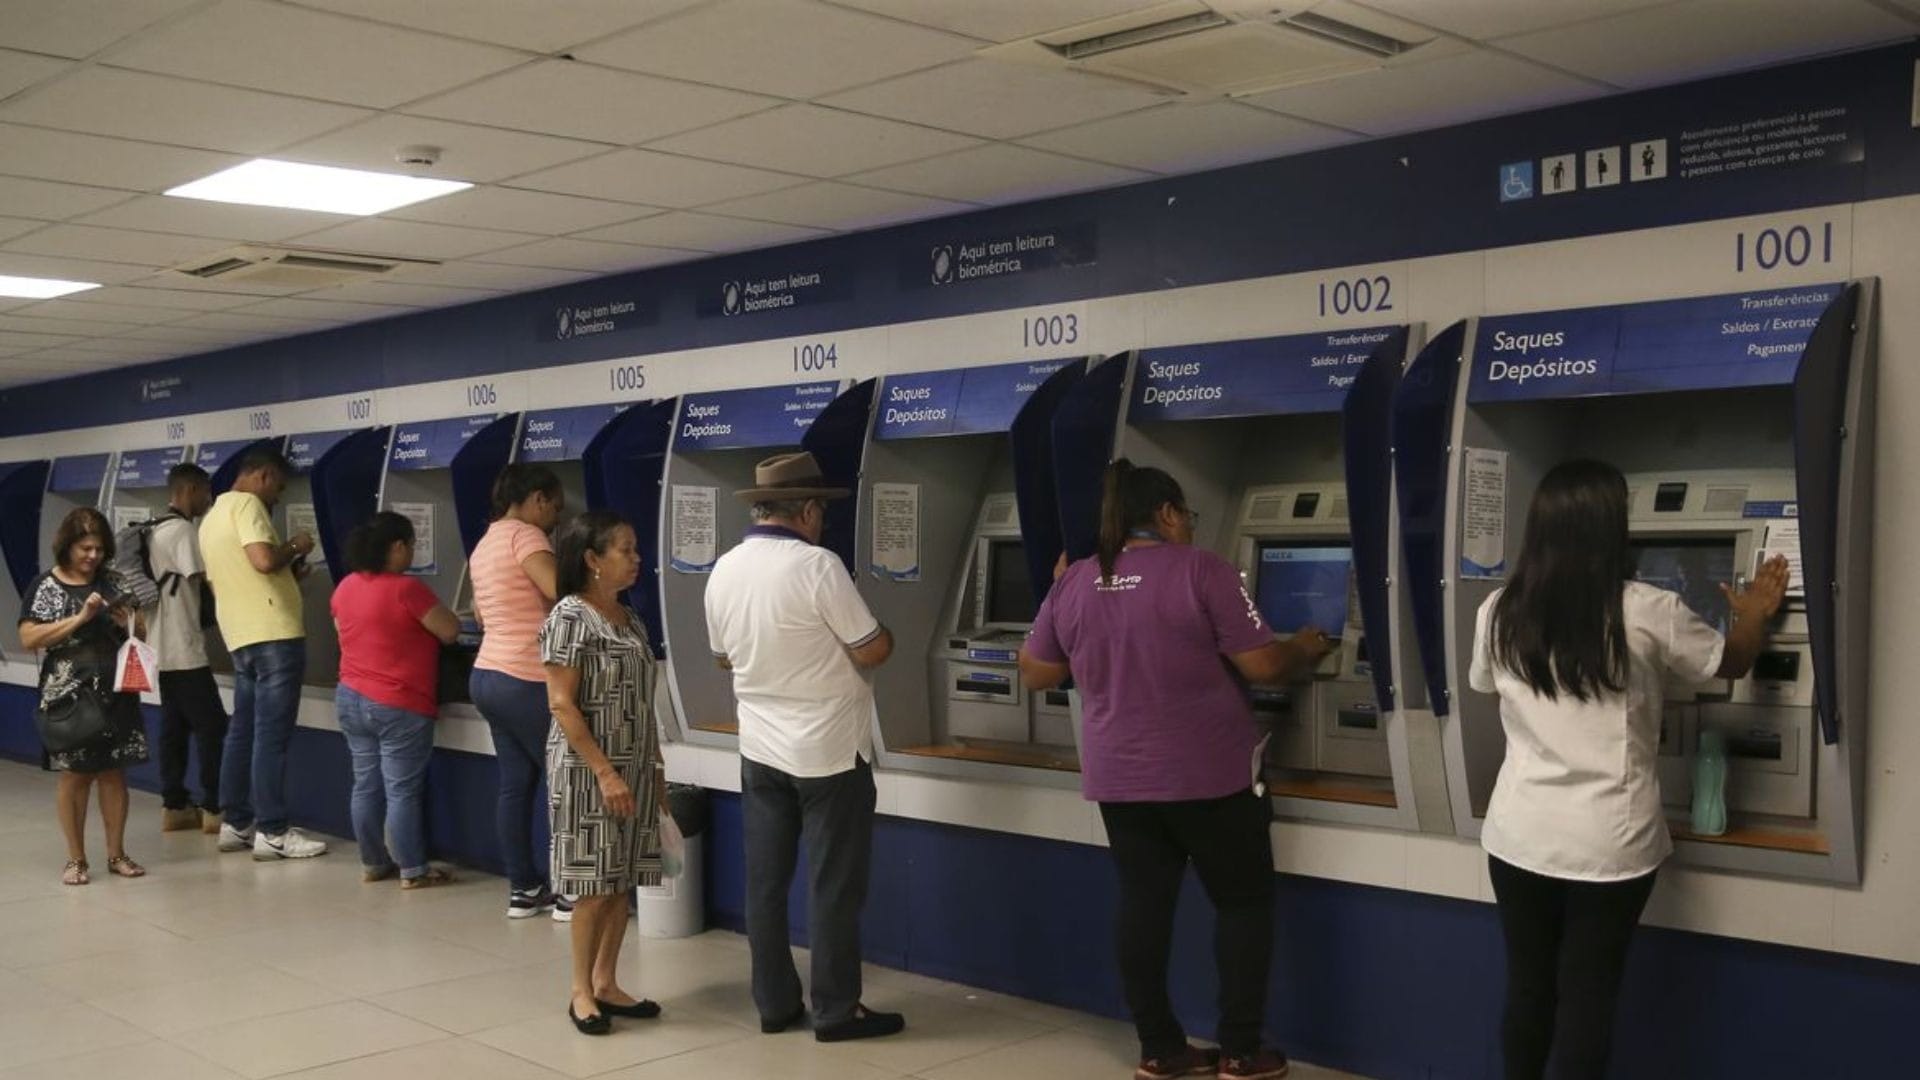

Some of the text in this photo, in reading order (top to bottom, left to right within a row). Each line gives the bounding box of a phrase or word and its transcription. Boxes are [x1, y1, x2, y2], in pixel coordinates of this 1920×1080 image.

[1680, 125, 1740, 141] Atendimento
[1742, 112, 1798, 131] preferencial
[1807, 107, 1847, 121] pessoas
[1680, 143, 1700, 152] com
[1752, 133, 1765, 141] ou
[1767, 124, 1819, 139] mobilidade
[1803, 132, 1847, 146] lactantes
[1688, 165, 1723, 178] pessoas
[1725, 160, 1747, 171] com
[1748, 153, 1786, 167] crianças
[1788, 151, 1801, 161] de
[959, 233, 1055, 263] Aqui tem leitura
[1737, 222, 1832, 272] 1001
[959, 258, 1021, 280] biométrica
[744, 272, 821, 297] Aqui tem leitura
[744, 293, 794, 312] biométrica
[1319, 275, 1393, 317] 1002
[1741, 291, 1830, 310] Transferências
[574, 301, 636, 321] Aqui tem leitura
[574, 320, 615, 335] biométrica
[1023, 313, 1078, 348] 1003
[1721, 322, 1760, 335] Saldos
[1772, 315, 1819, 330] Extrato
[1327, 331, 1389, 346] Transferência
[1493, 329, 1565, 355] Saques
[793, 343, 838, 372] 1004
[1747, 341, 1807, 359] Pagament
[1311, 355, 1339, 367] Saldos
[1488, 356, 1598, 385] Depósitos
[610, 365, 645, 391] 1005
[1148, 360, 1200, 383] Saques
[467, 383, 497, 407] 1006
[890, 386, 931, 404] Saques
[1143, 383, 1223, 408] Depósitos
[347, 398, 371, 421] 1007
[687, 403, 720, 421] Saques
[885, 406, 947, 426] Depósitos
[167, 422, 185, 440] 1009
[250, 411, 271, 432] 1008
[528, 419, 554, 434] Saques
[682, 422, 732, 440] Depósitos
[398, 431, 421, 446] Saques
[523, 436, 563, 451] Depósitos
[394, 446, 427, 461] Depósitos
[1094, 575, 1142, 585] AENTO
